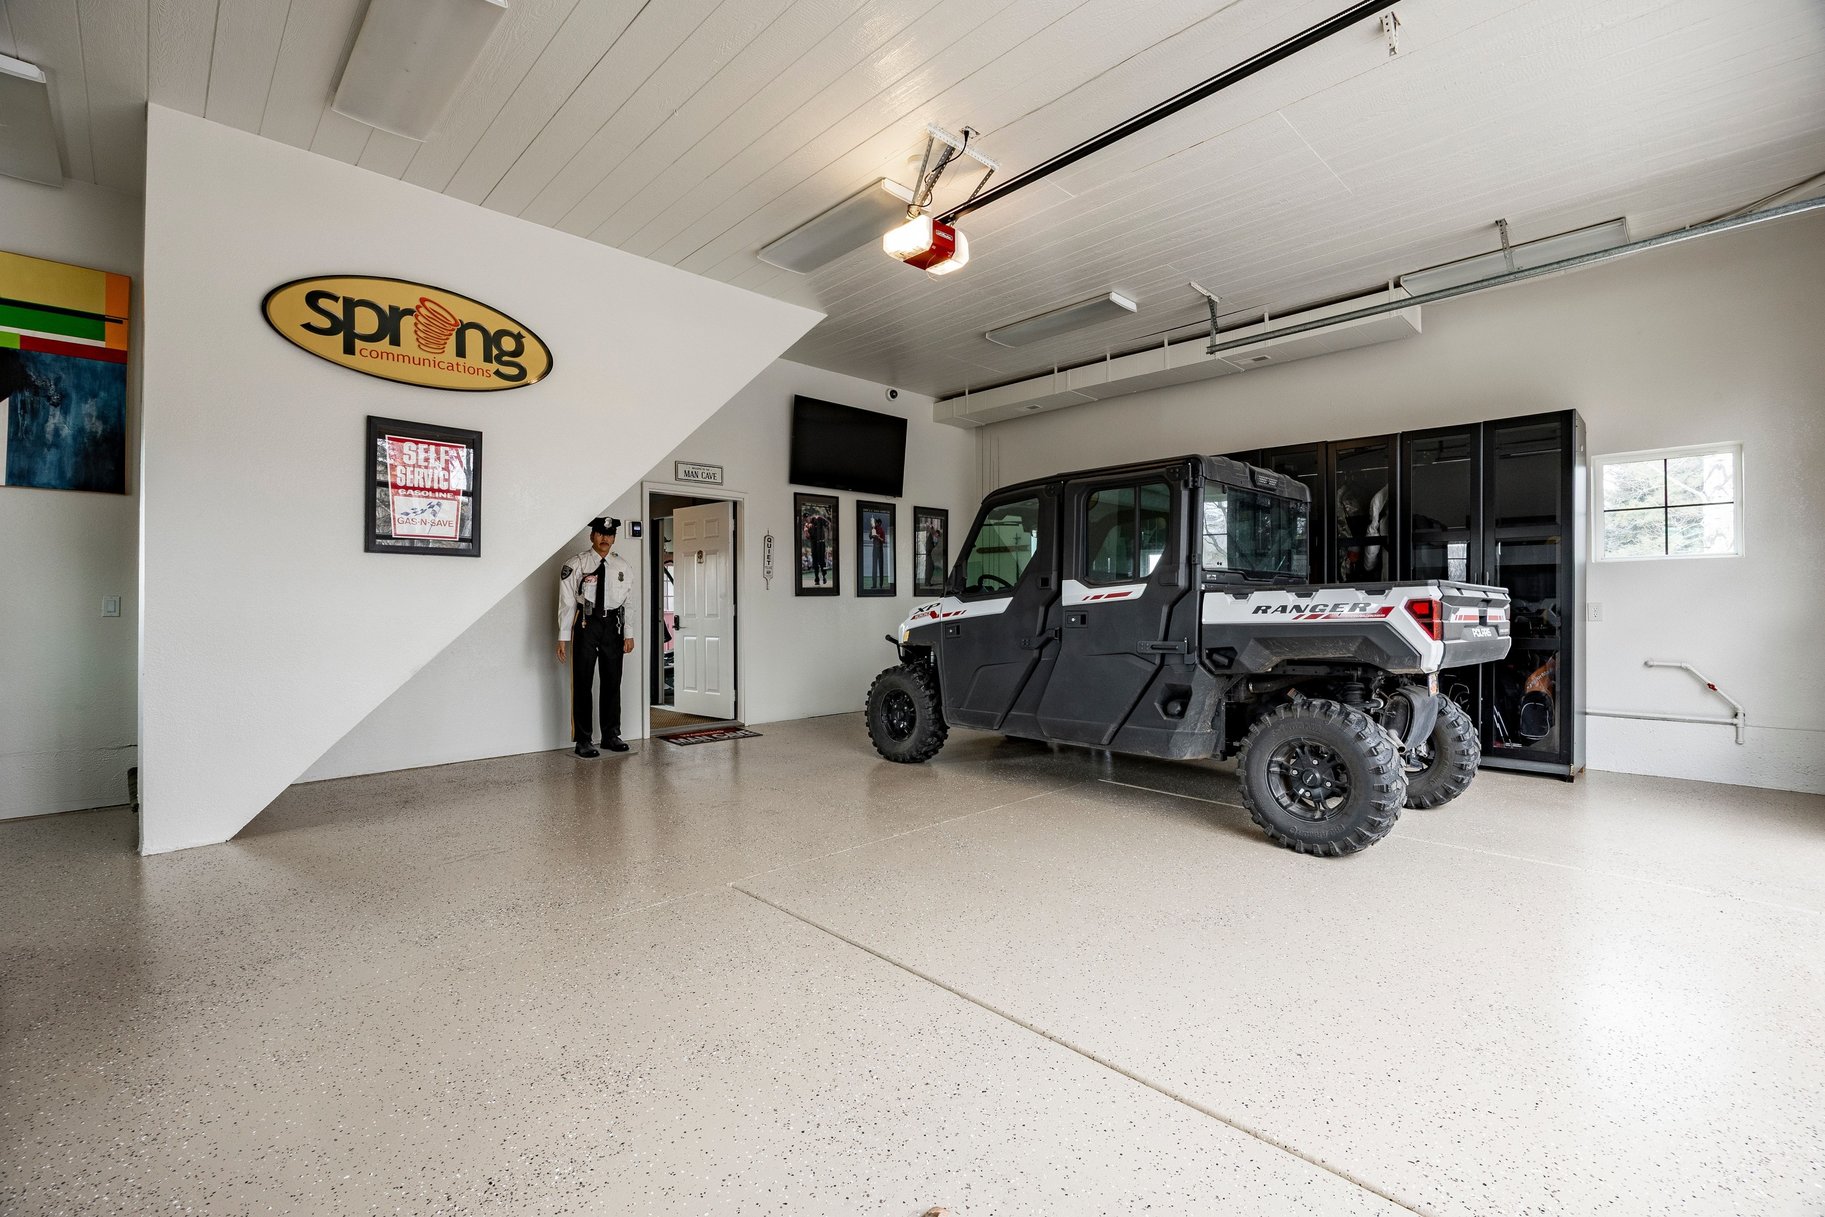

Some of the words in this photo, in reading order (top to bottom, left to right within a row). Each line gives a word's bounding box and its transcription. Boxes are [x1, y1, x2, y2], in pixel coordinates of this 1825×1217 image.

[359, 347, 492, 378] communications
[402, 441, 450, 468] SELF
[684, 470, 699, 479] MAN
[701, 471, 718, 481] CAVE
[398, 488, 455, 499] GASOLINE
[914, 602, 941, 615] XP
[1251, 601, 1374, 615] RANGER
